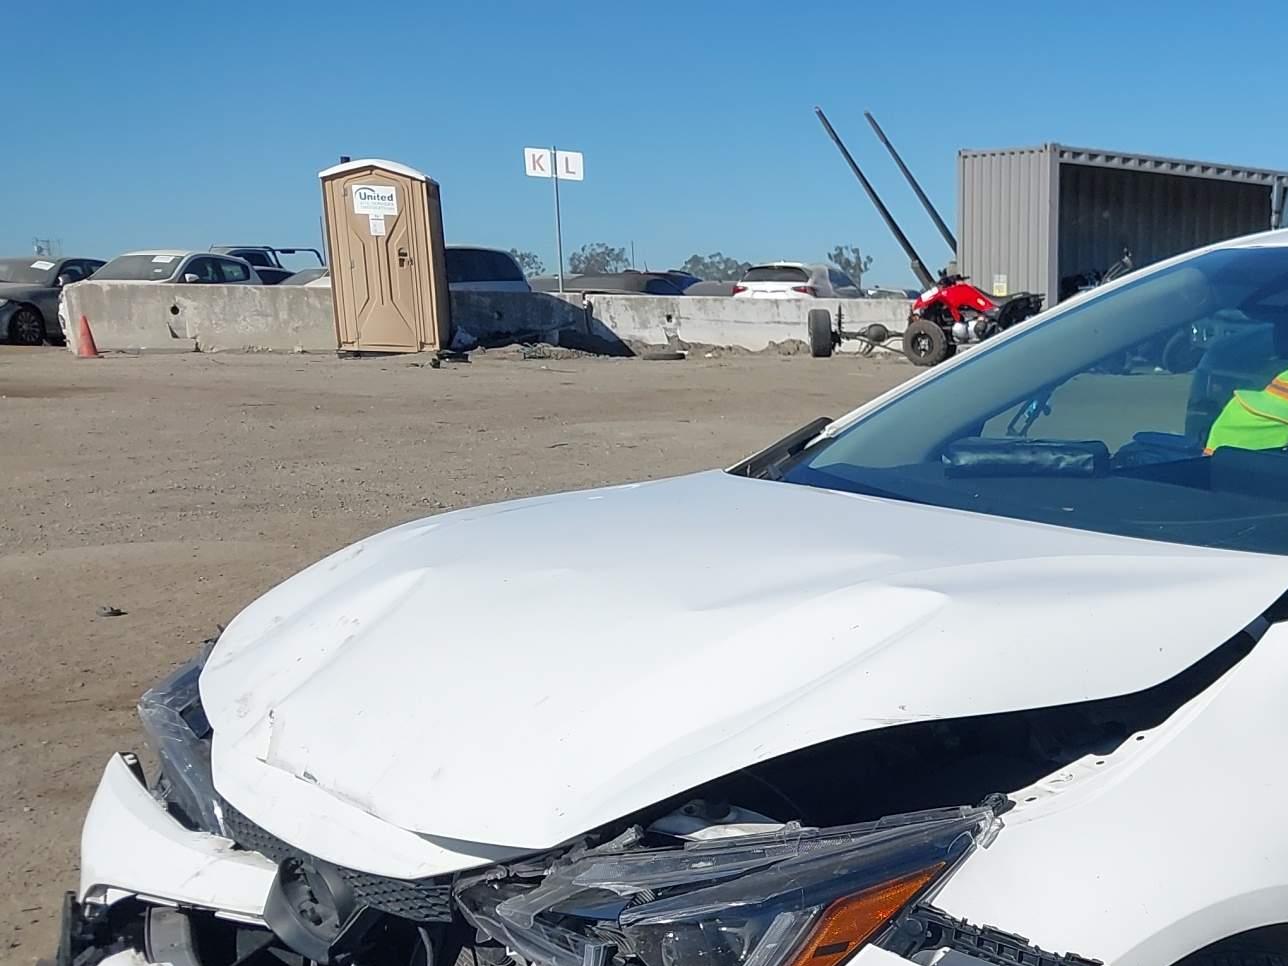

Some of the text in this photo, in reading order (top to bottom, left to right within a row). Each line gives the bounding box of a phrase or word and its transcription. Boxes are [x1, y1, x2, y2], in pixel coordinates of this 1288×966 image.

[532, 153, 545, 171] K
[565, 157, 577, 175] L
[358, 191, 393, 202] United
